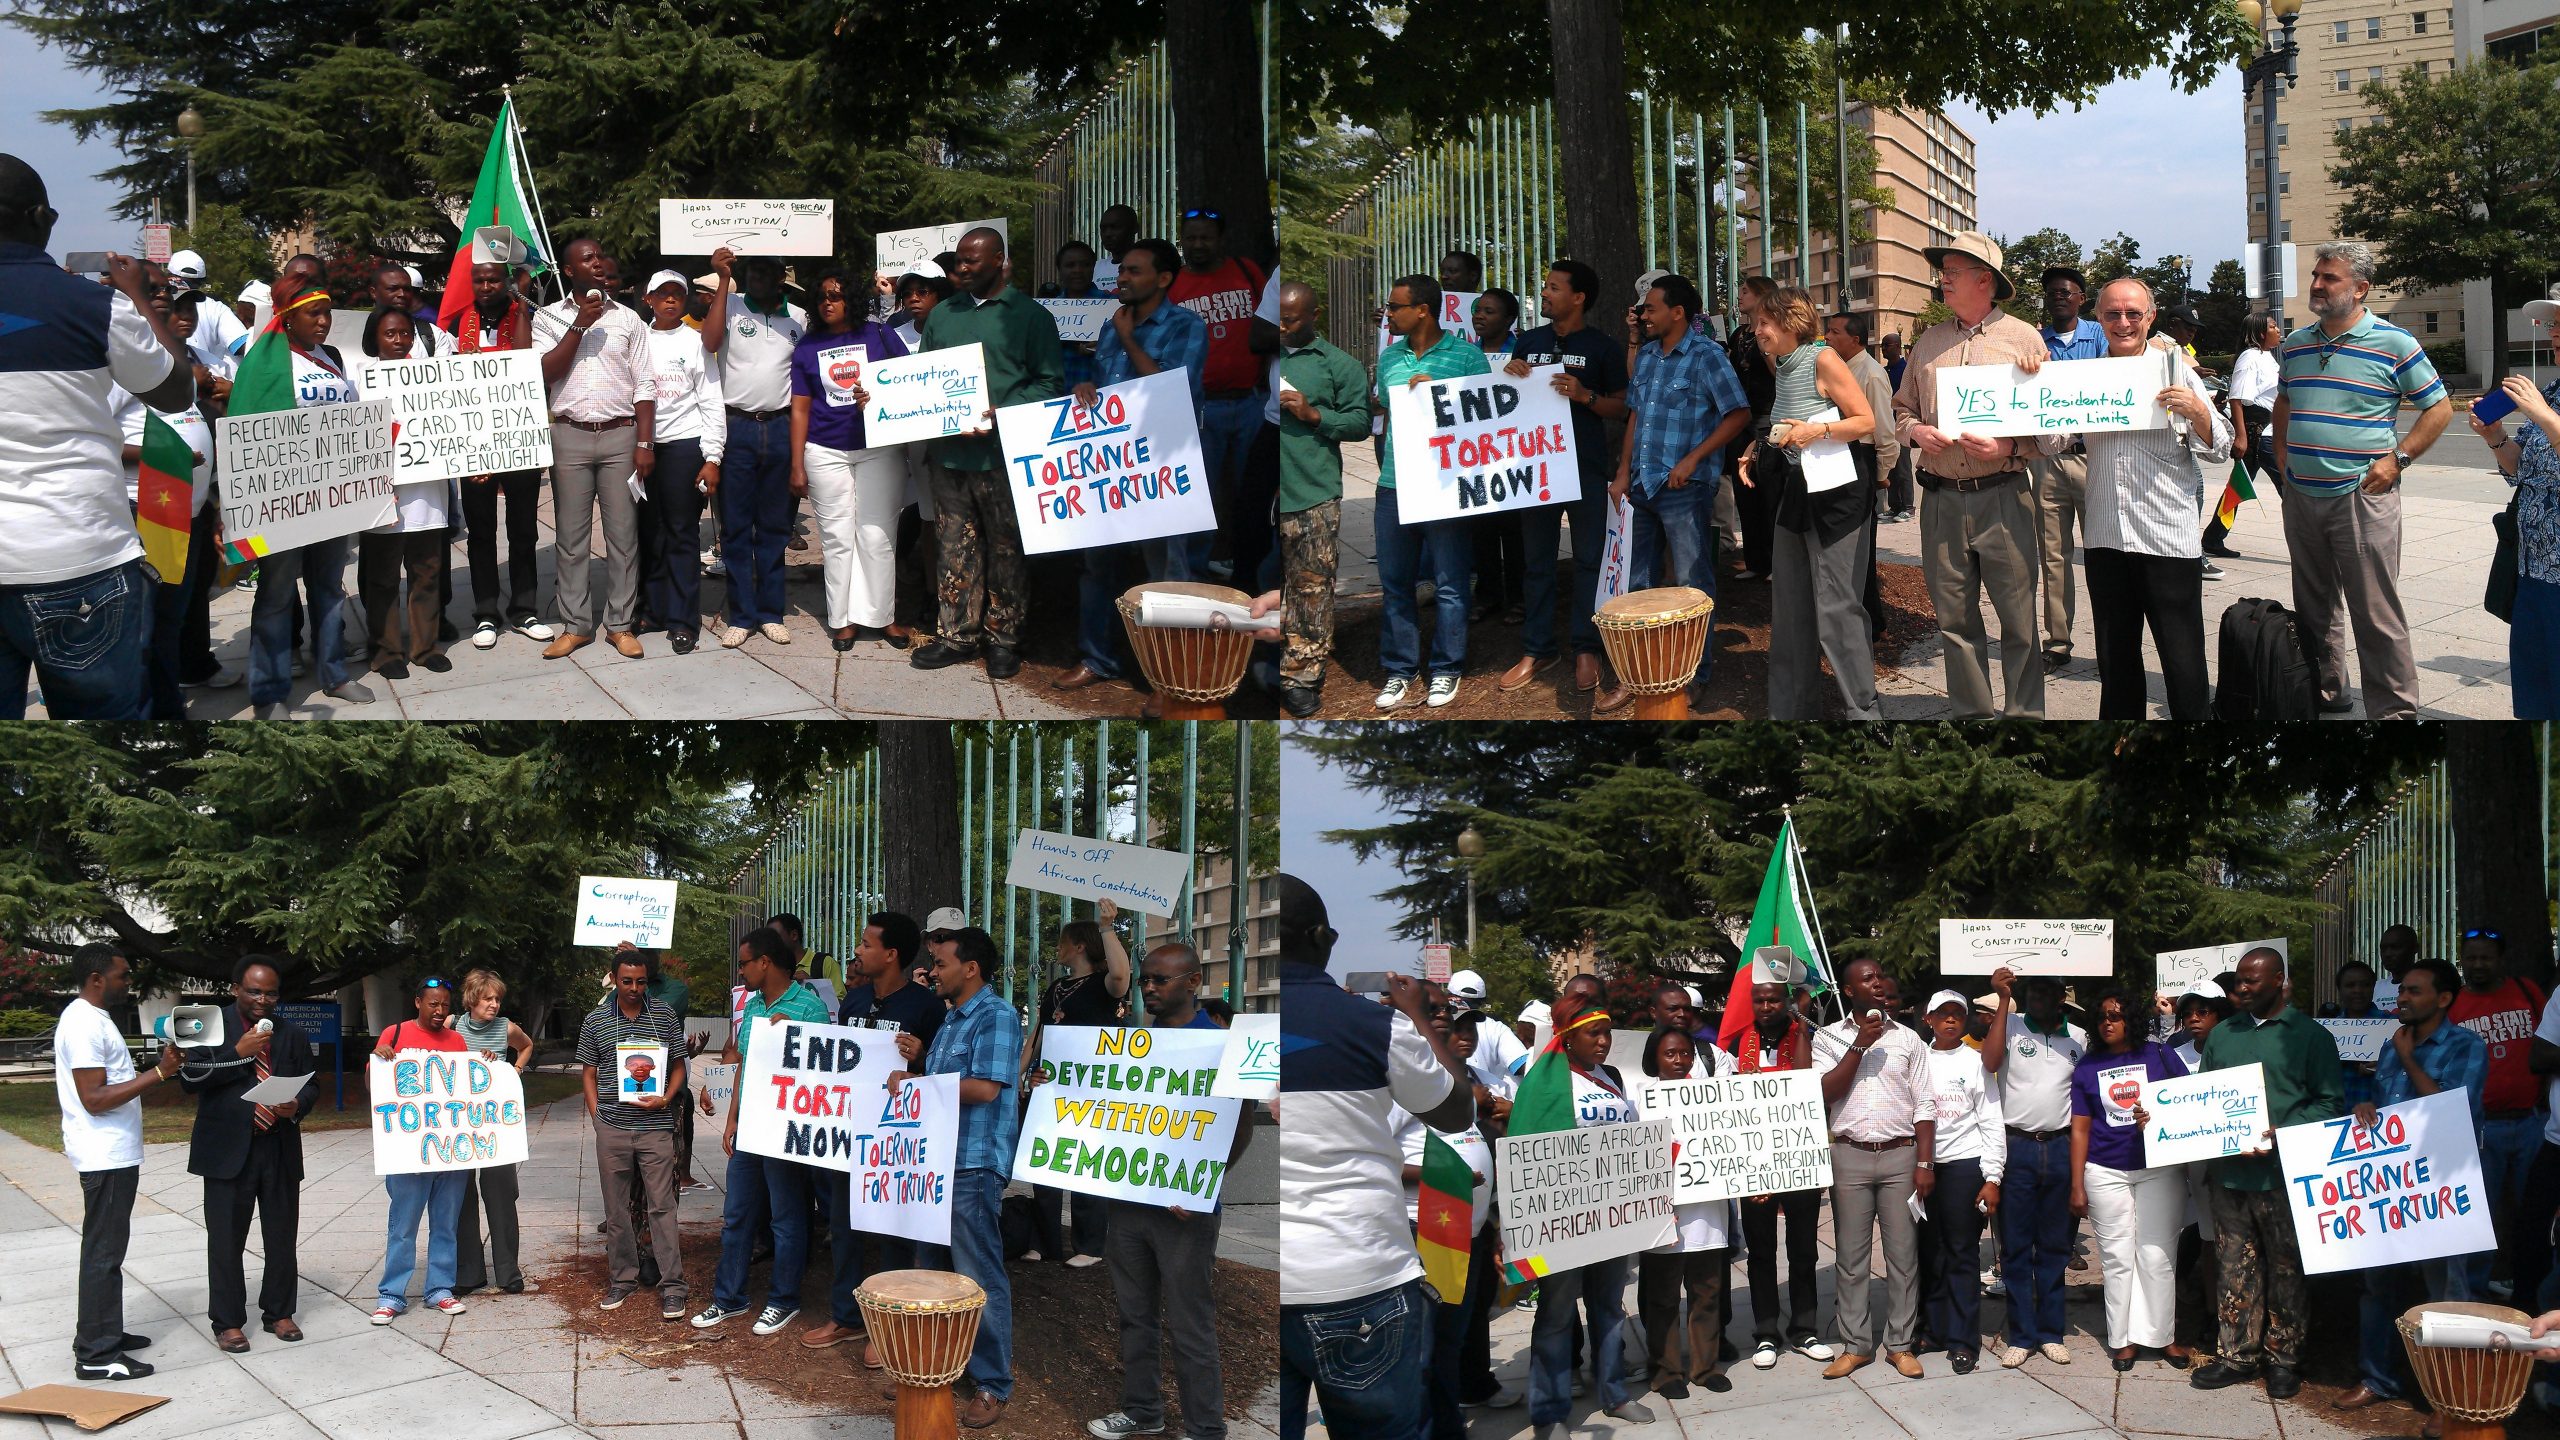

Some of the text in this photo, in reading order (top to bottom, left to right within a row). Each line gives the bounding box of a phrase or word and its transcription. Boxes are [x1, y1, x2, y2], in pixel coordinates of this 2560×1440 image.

[682, 203, 711, 214] HANDS
[763, 202, 786, 210] OUR
[878, 254, 906, 268] Human
[1212, 289, 1252, 310] STATE
[473, 357, 512, 379] NOT
[833, 367, 842, 375] WE
[1527, 354, 1539, 363] WE
[833, 372, 856, 381] AFRICA
[877, 366, 959, 386] Corruption
[402, 387, 481, 413] NURSING
[488, 381, 540, 403] HOME
[1430, 383, 1520, 427] END
[1956, 386, 2135, 413] YES to Presidential
[229, 413, 310, 445] RECEIVING
[320, 404, 383, 431] AFRICAN
[407, 414, 457, 438] CARD
[460, 411, 483, 431] TO
[943, 414, 959, 429] IN
[2033, 411, 2130, 428] Term Limits
[230, 428, 386, 473] LEADERS IN THE US
[398, 427, 551, 468] 32 YEARS AS PRESIDENT
[1429, 424, 1567, 470] TORTURE
[230, 451, 392, 499] IS AN EXPLICIT SUPPORT
[445, 458, 460, 475] IS
[1038, 465, 1191, 524] FOR TORTURE
[1456, 462, 1551, 509] NOW!
[225, 474, 395, 531] TO AFRICAN DICTATORS
[1032, 836, 1115, 863] Hands Off
[593, 884, 656, 904] Corruption
[1038, 862, 1168, 907] African Constitutions
[636, 932, 650, 943] IN
[1962, 923, 1991, 934] HANDS
[2043, 922, 2066, 930] OUR
[2158, 974, 2186, 988] Human
[2492, 1009, 2532, 1030] STATE
[782, 1025, 862, 1073] END
[1095, 1028, 1152, 1059] NO
[394, 1054, 492, 1097] END
[705, 1065, 725, 1077] LIFE
[771, 1074, 851, 1119] TORT
[880, 1082, 921, 1122] ZERO
[1753, 1077, 1792, 1099] NOT
[2113, 1087, 2122, 1095] WE
[2113, 1092, 2136, 1101] AFRICA
[2157, 1086, 2239, 1106] Corruption
[374, 1100, 522, 1133] TORTURE
[1682, 1107, 1761, 1133] NURSING
[1768, 1101, 1820, 1123] HOME
[421, 1131, 497, 1165] NOW
[784, 1120, 851, 1160] NOW
[1509, 1133, 1590, 1165] RECEIVING
[1600, 1124, 1663, 1151] AFRICAN
[1687, 1134, 1737, 1158] CARD
[1740, 1131, 1763, 1151] TO
[2223, 1134, 2239, 1149] IN
[1029, 1136, 1227, 1200] DEMOCRACY
[1510, 1148, 1666, 1193] LEADERS IN THE US
[1678, 1147, 1831, 1188] 32 YEARS AS PRESIDENT
[862, 1171, 944, 1205] FOR TORTURE
[1510, 1171, 1672, 1219] IS AN EXPLICIT SUPPORT
[1725, 1178, 1740, 1195] IS
[1505, 1194, 1675, 1251] TO AFRICAN DICTATORS
[2318, 1185, 2471, 1244] FOR TORTURE
